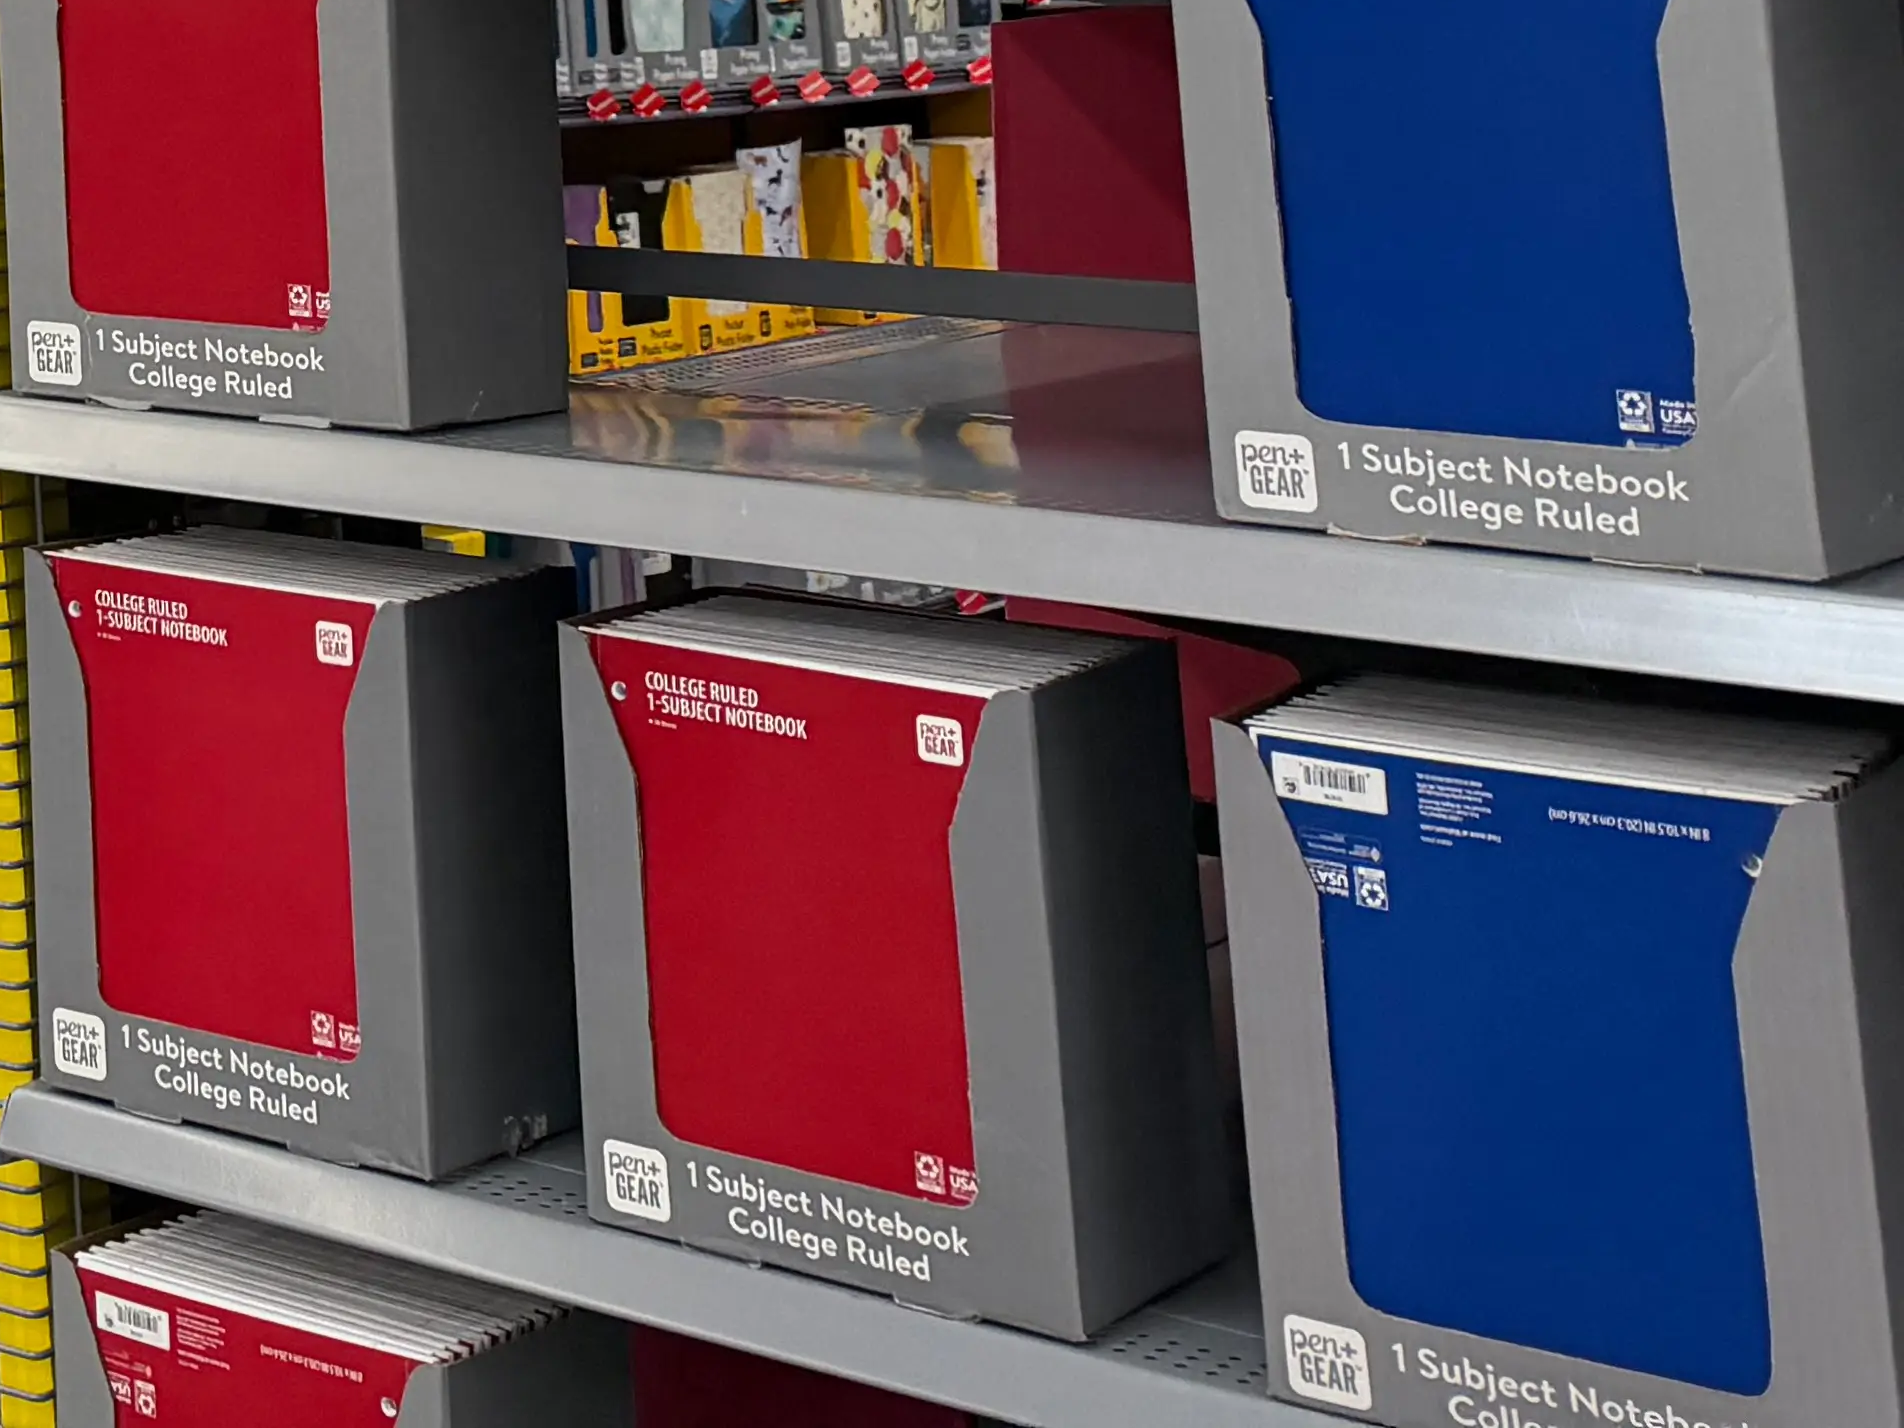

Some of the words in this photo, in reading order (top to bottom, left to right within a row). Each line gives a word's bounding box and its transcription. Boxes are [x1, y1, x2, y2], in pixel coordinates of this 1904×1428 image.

[1250, 465, 1311, 500] GEAR
[1338, 443, 1350, 470] 1
[1362, 445, 1493, 485] Subject
[1503, 457, 1690, 501] Notebook
[1390, 484, 1524, 530] College
[1536, 498, 1640, 537] Ruled
